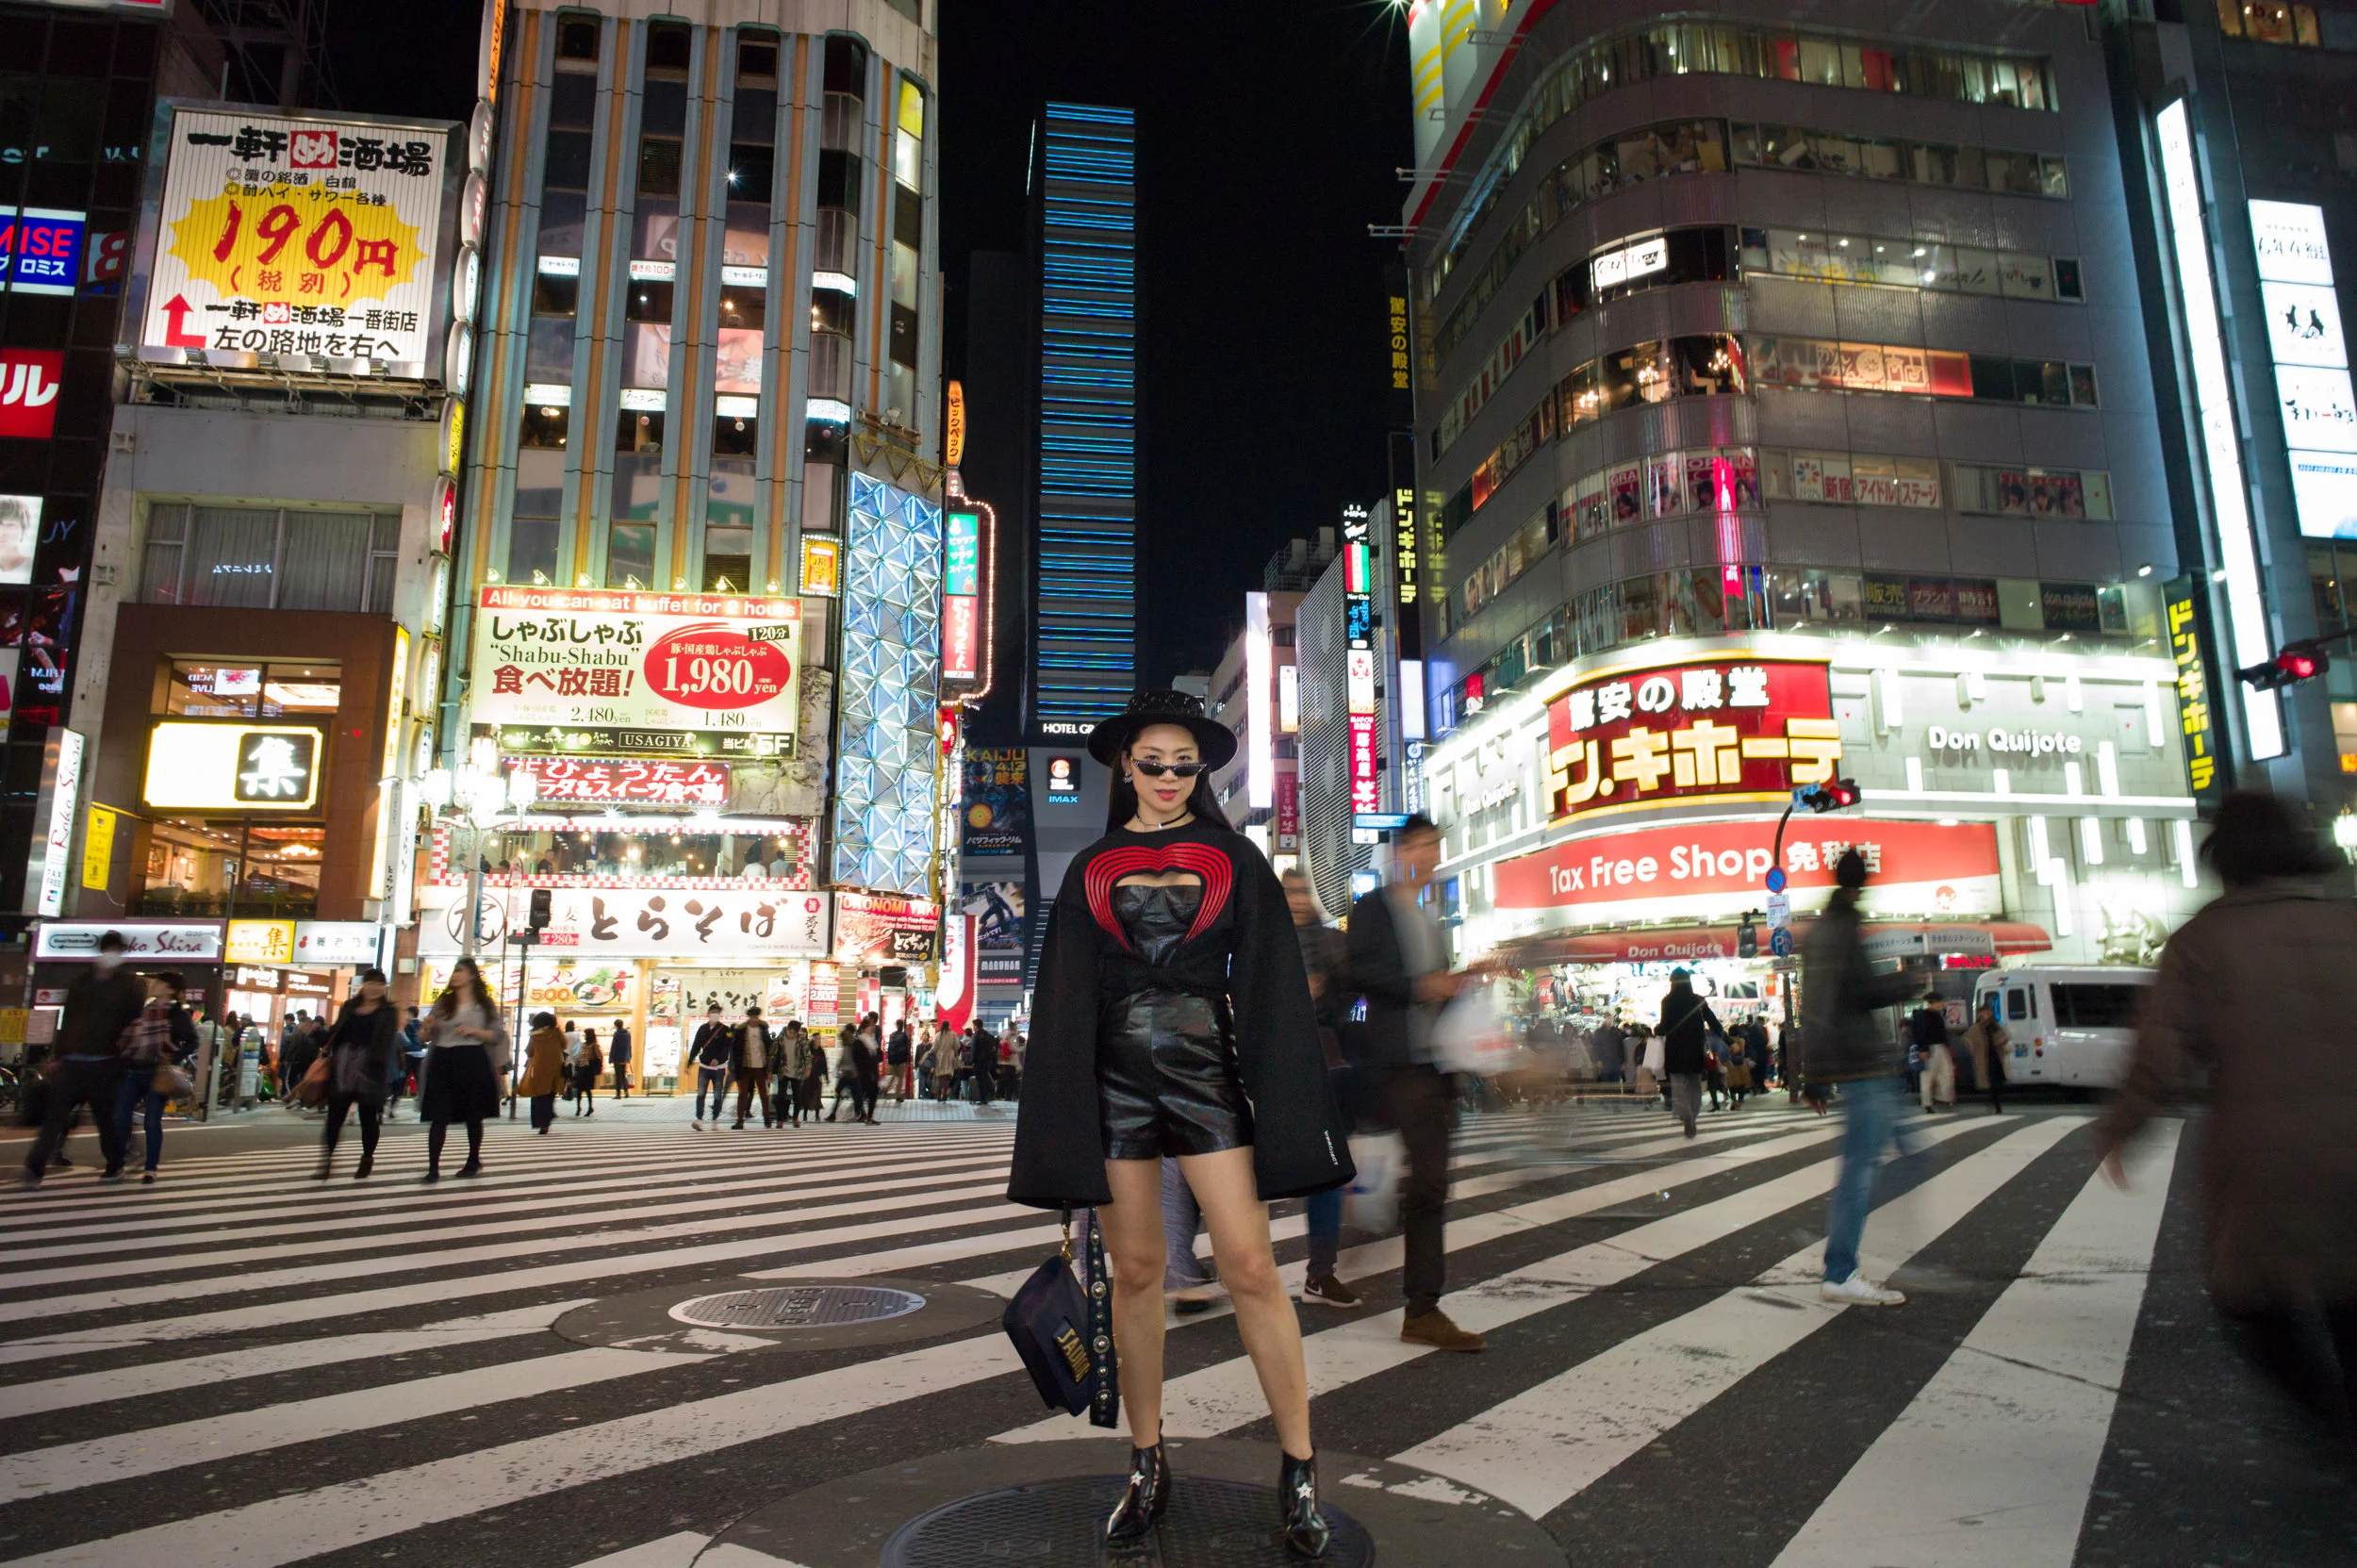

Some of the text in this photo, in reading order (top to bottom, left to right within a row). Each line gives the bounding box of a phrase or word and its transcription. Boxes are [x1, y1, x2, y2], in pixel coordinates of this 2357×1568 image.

[188, 125, 432, 176] 一軒め酒場
[213, 200, 399, 278] 190円
[214, 325, 400, 357] 左の路地を右へ
[1390, 296, 1409, 389] 驚安の殿堂
[635, 596, 689, 613] buffet
[694, 599, 721, 614] for
[727, 600, 739, 614] 2
[744, 601, 796, 617] hours
[492, 616, 645, 645] しゃぶしゃぶ
[662, 656, 778, 698] 1,980 yen
[1569, 667, 1770, 733] 驚安の殿堂
[625, 734, 691, 748] USAGIYA
[1043, 722, 1078, 734] HOTEL
[1928, 726, 2082, 757] Don Quijote
[239, 735, 305, 798] 集
[966, 749, 1026, 762] KAIJU
[546, 761, 722, 784] ひょうたん
[1048, 795, 1079, 803] IMAX
[1549, 864, 1585, 896] Tax
[1591, 855, 1658, 888] Free
[1669, 844, 1772, 886] Shop
[591, 895, 789, 944] とらそば
[260, 927, 289, 957] 集
[1627, 943, 1724, 961] Don Quijote
